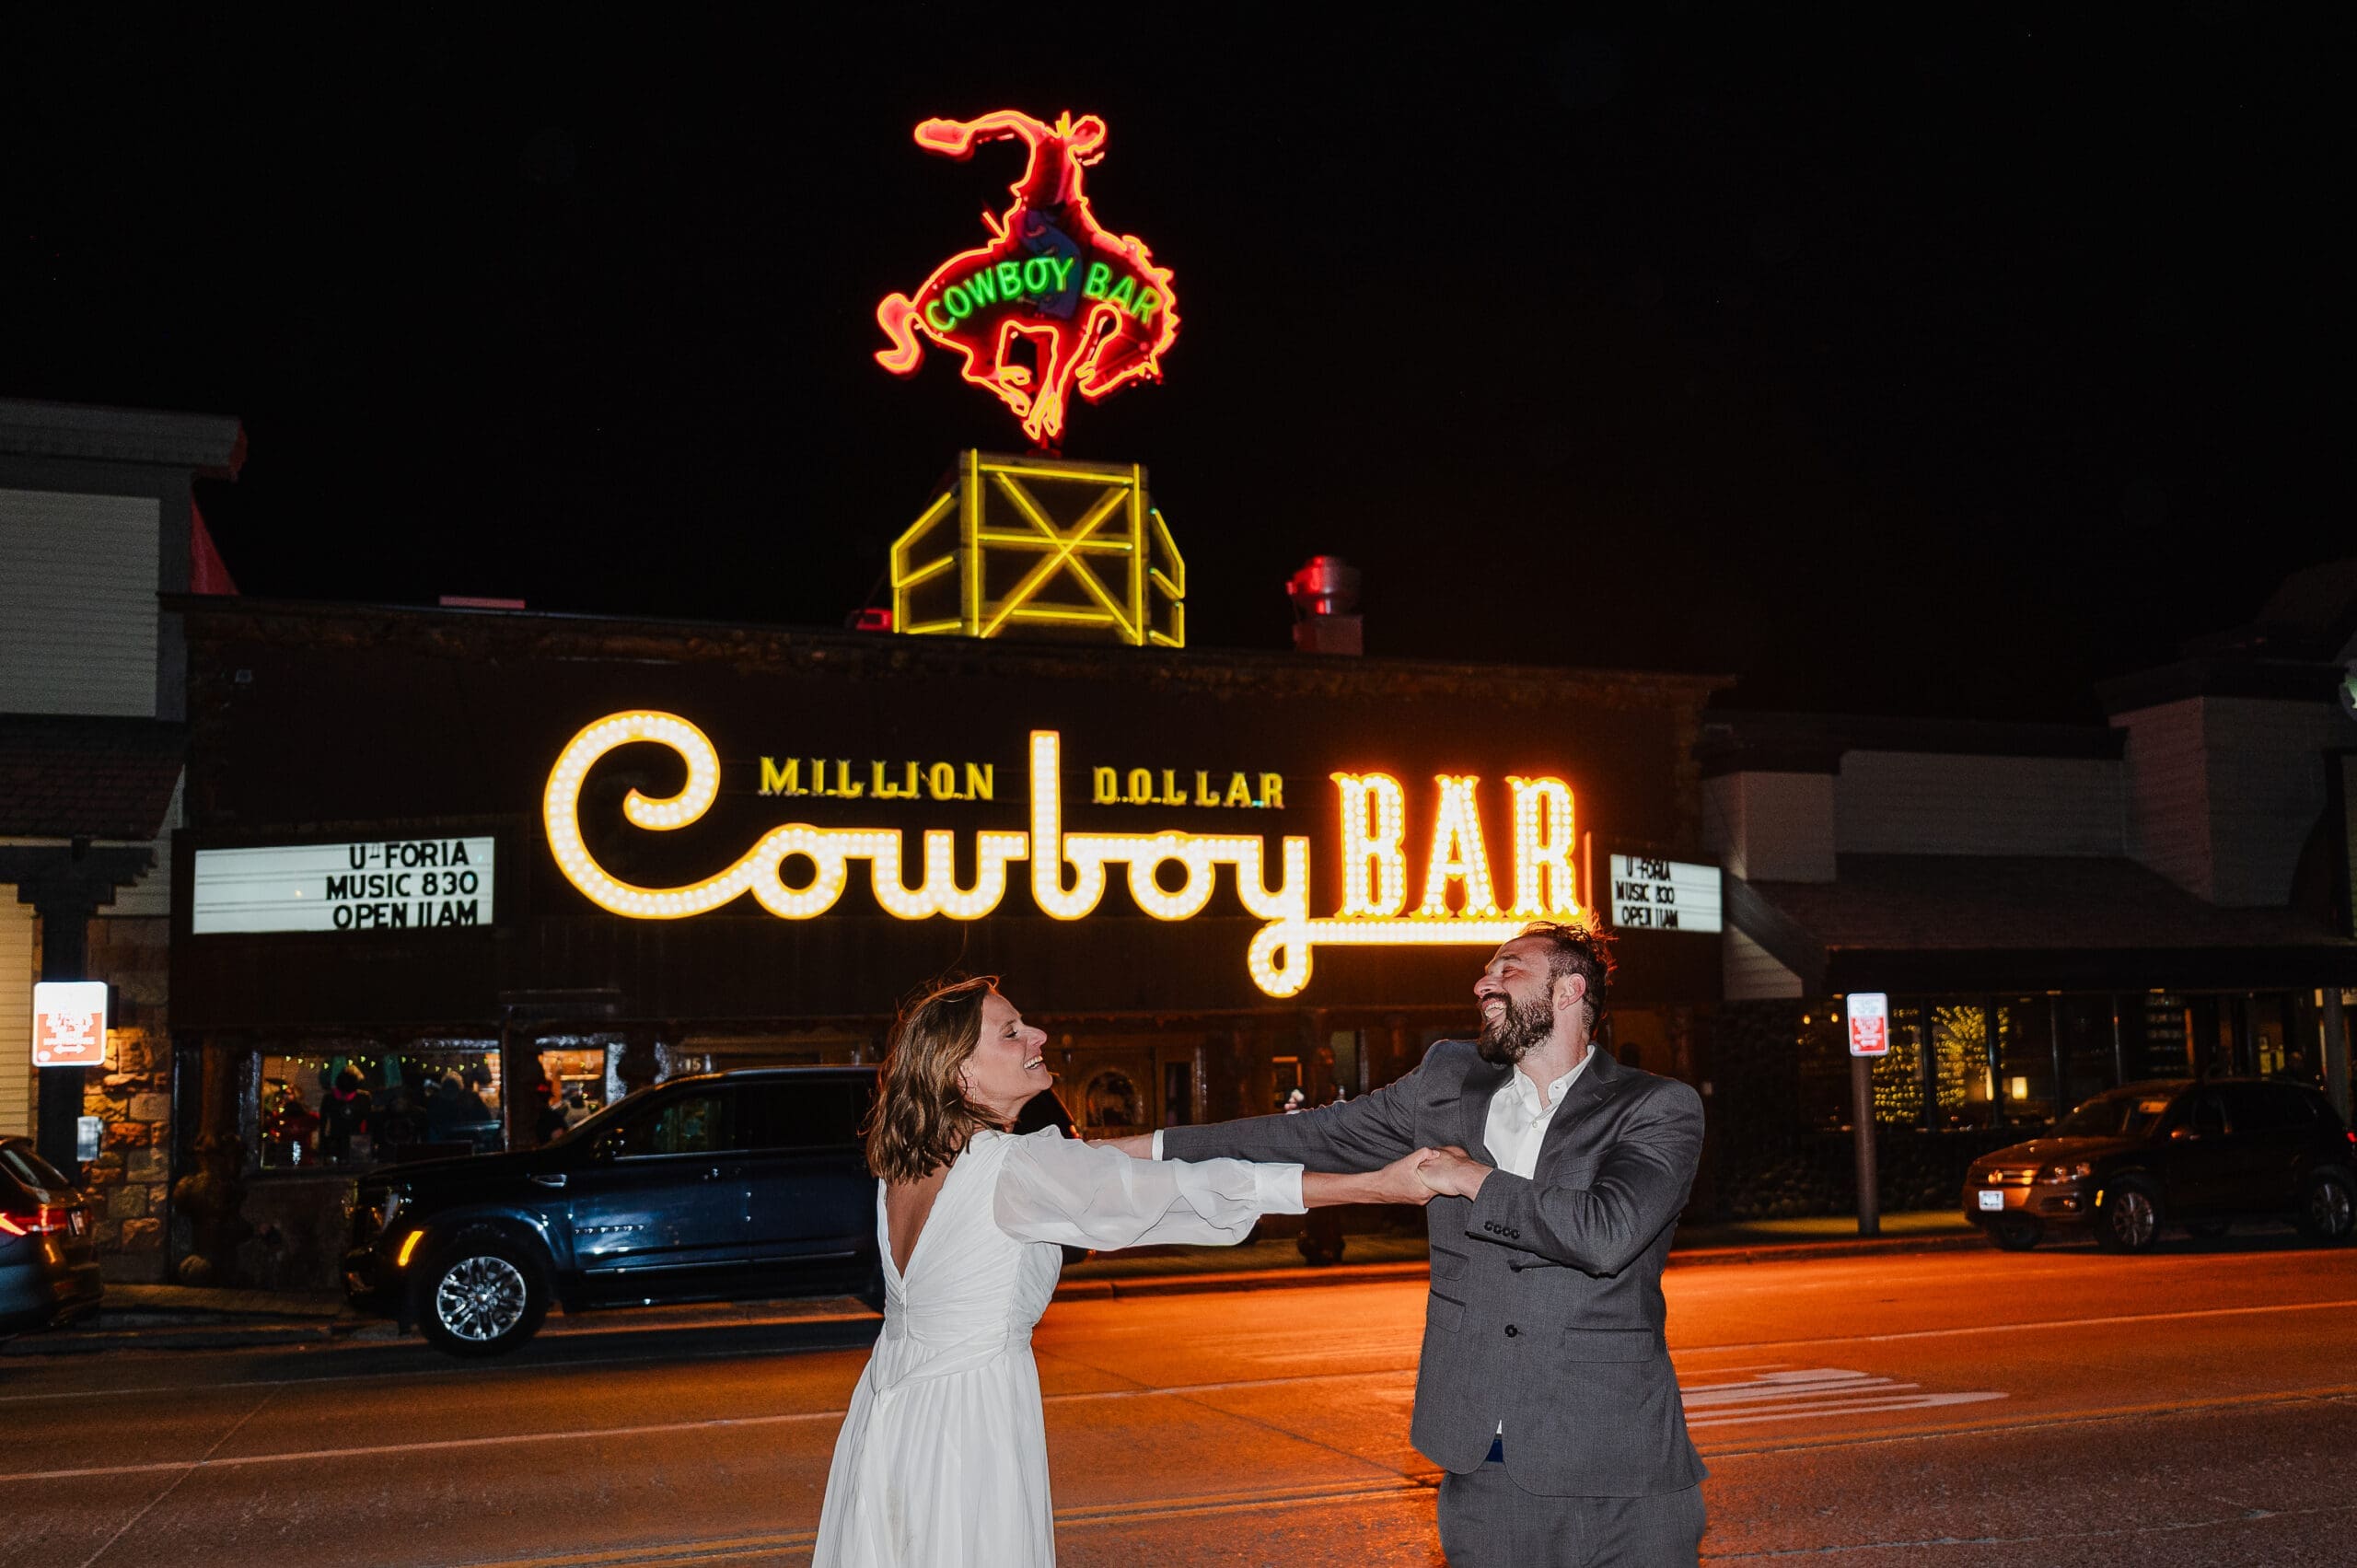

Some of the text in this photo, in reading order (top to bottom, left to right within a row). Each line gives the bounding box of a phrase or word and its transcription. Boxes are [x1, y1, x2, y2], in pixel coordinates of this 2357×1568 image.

[924, 257, 1161, 332] COWBOY BAR
[757, 756, 1285, 809] MILLION DOLLAR
[543, 709, 1588, 998] Cowboy BAR
[326, 870, 479, 900] MUSIC 830
[1616, 881, 1650, 902] MUSIC
[332, 902, 408, 929] OPEN
[1622, 906, 1652, 925] OPEN
